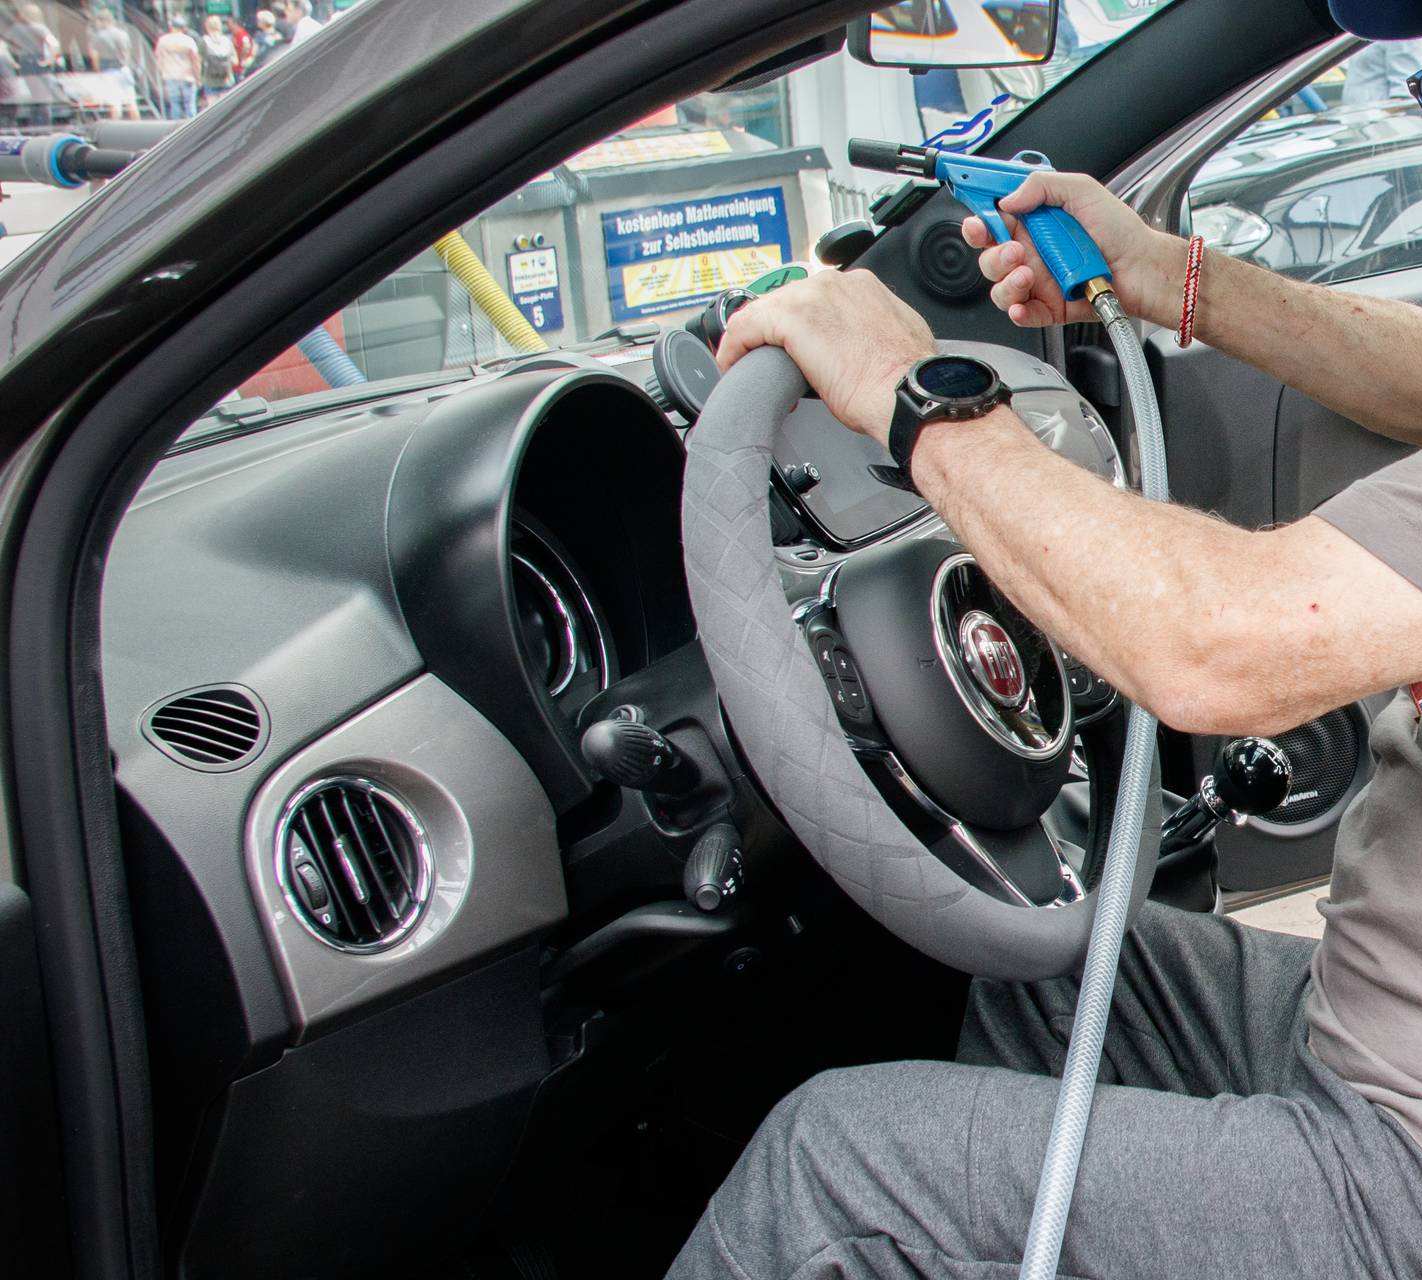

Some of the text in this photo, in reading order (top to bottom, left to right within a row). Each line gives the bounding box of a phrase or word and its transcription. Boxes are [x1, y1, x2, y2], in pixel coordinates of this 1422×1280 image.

[617, 196, 777, 235] kostenlose Mattenreinigung
[642, 223, 760, 256] zur Selbstbedienung
[533, 305, 545, 327] 5
[978, 638, 1017, 680] FIAT
